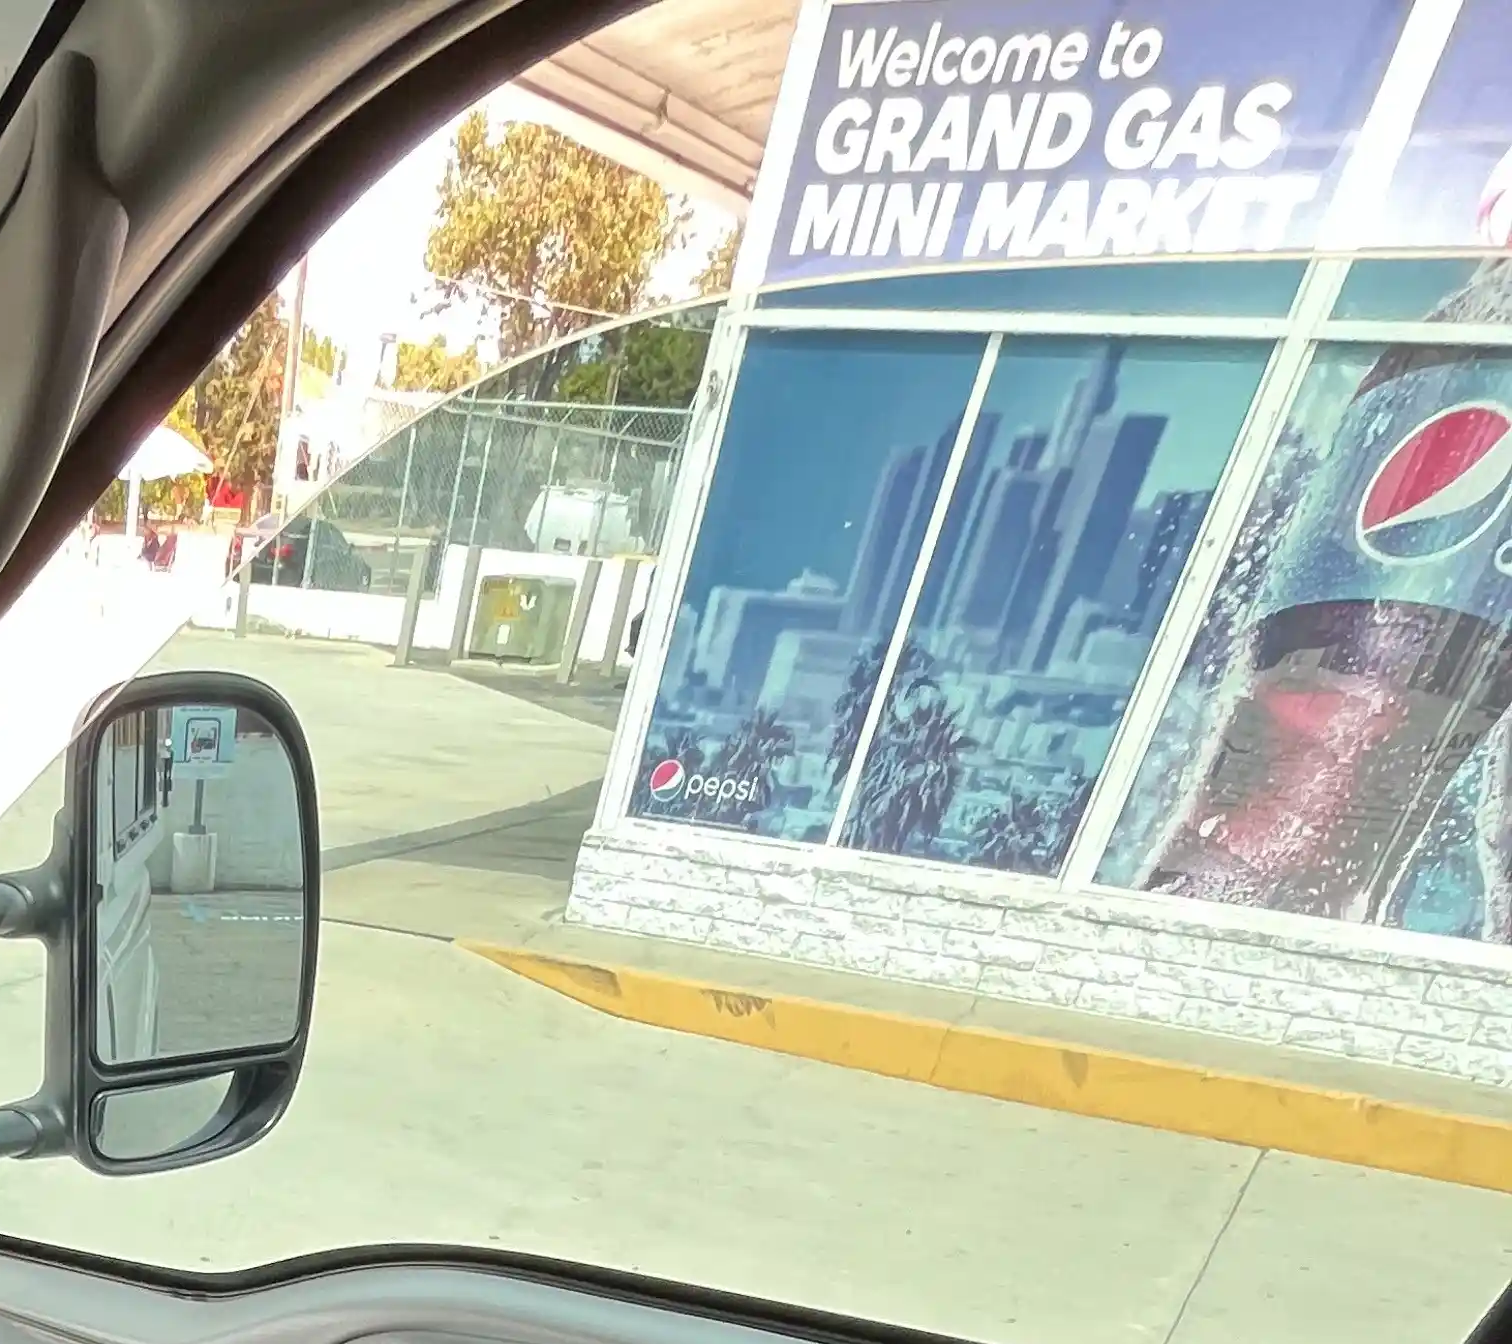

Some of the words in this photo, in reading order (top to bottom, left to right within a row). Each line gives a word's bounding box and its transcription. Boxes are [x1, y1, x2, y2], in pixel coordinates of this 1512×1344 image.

[837, 20, 1089, 89] Welcome
[1098, 20, 1164, 81] to
[814, 91, 1093, 175] GRAND
[1103, 80, 1293, 171] GAS
[789, 182, 963, 257] MINI
[962, 173, 1322, 257] MARKET
[684, 774, 759, 804] pepsi
